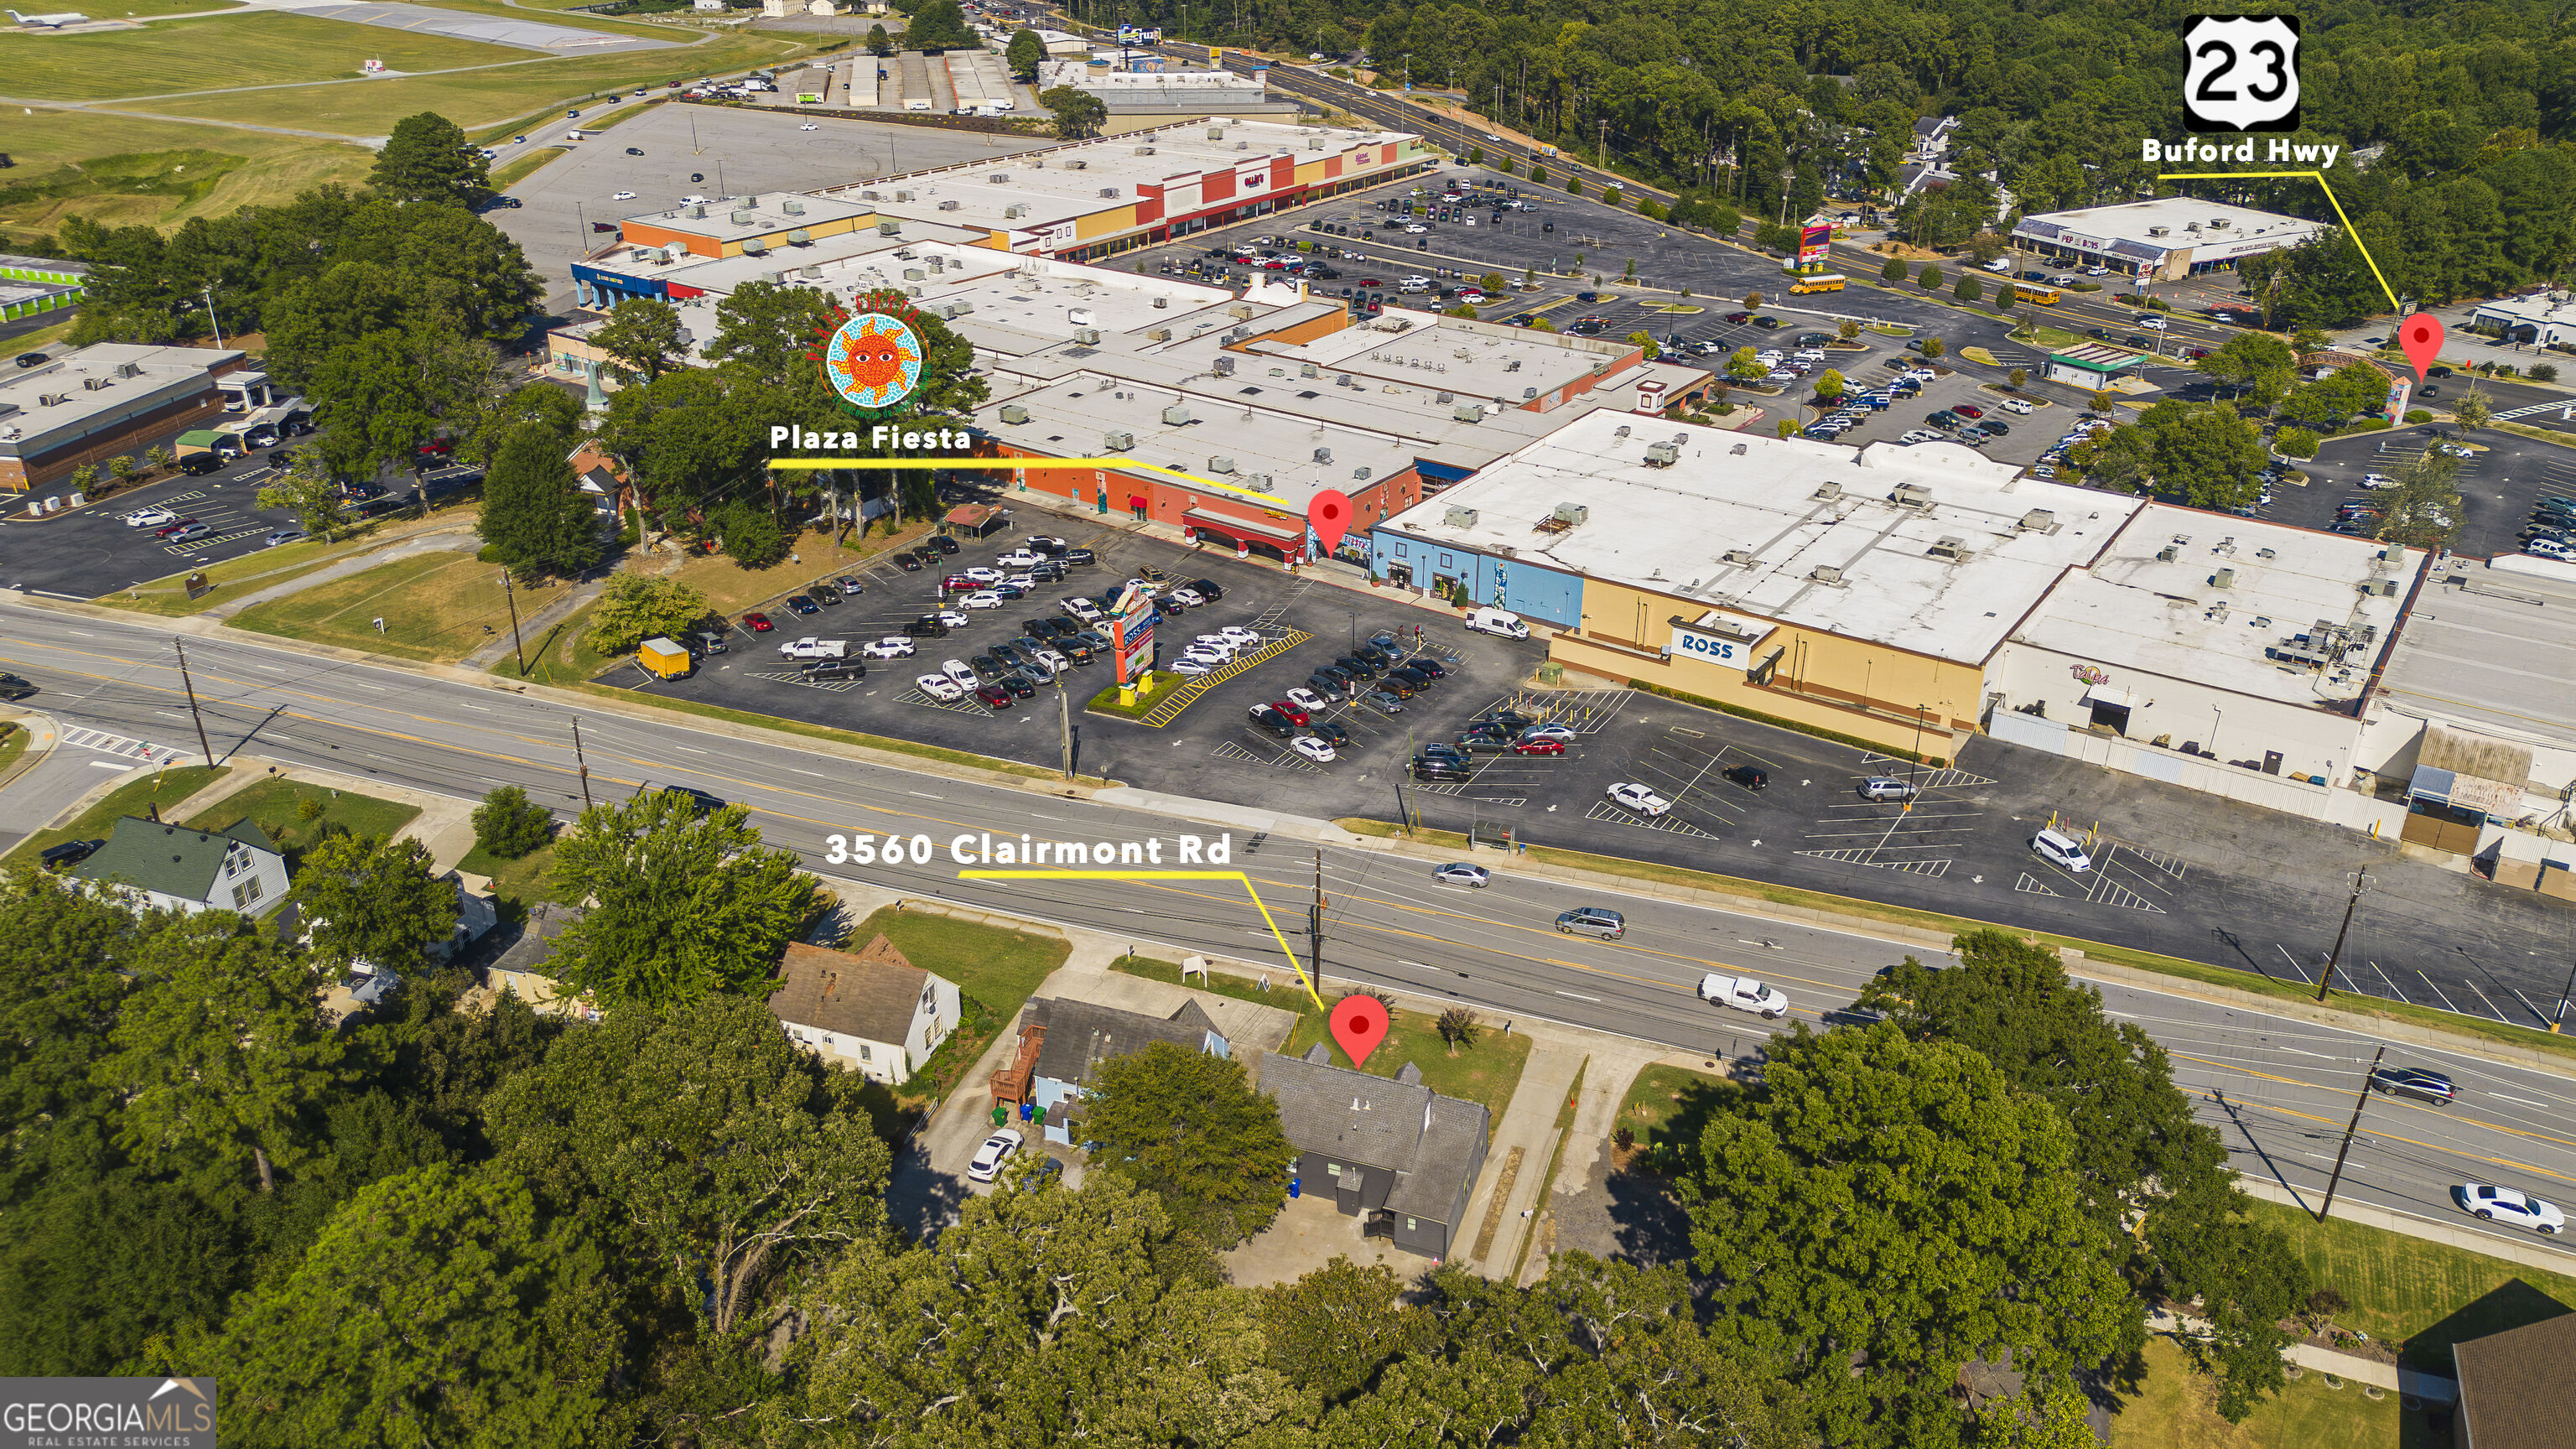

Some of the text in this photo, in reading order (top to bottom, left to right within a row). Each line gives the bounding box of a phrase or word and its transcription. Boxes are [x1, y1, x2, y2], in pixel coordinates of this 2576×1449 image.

[2061, 235, 2099, 249] PEP BOYS
[1124, 626, 1141, 645] ROSS
[1682, 634, 1733, 659] ROSS
[2070, 664, 2110, 686] Talpa
